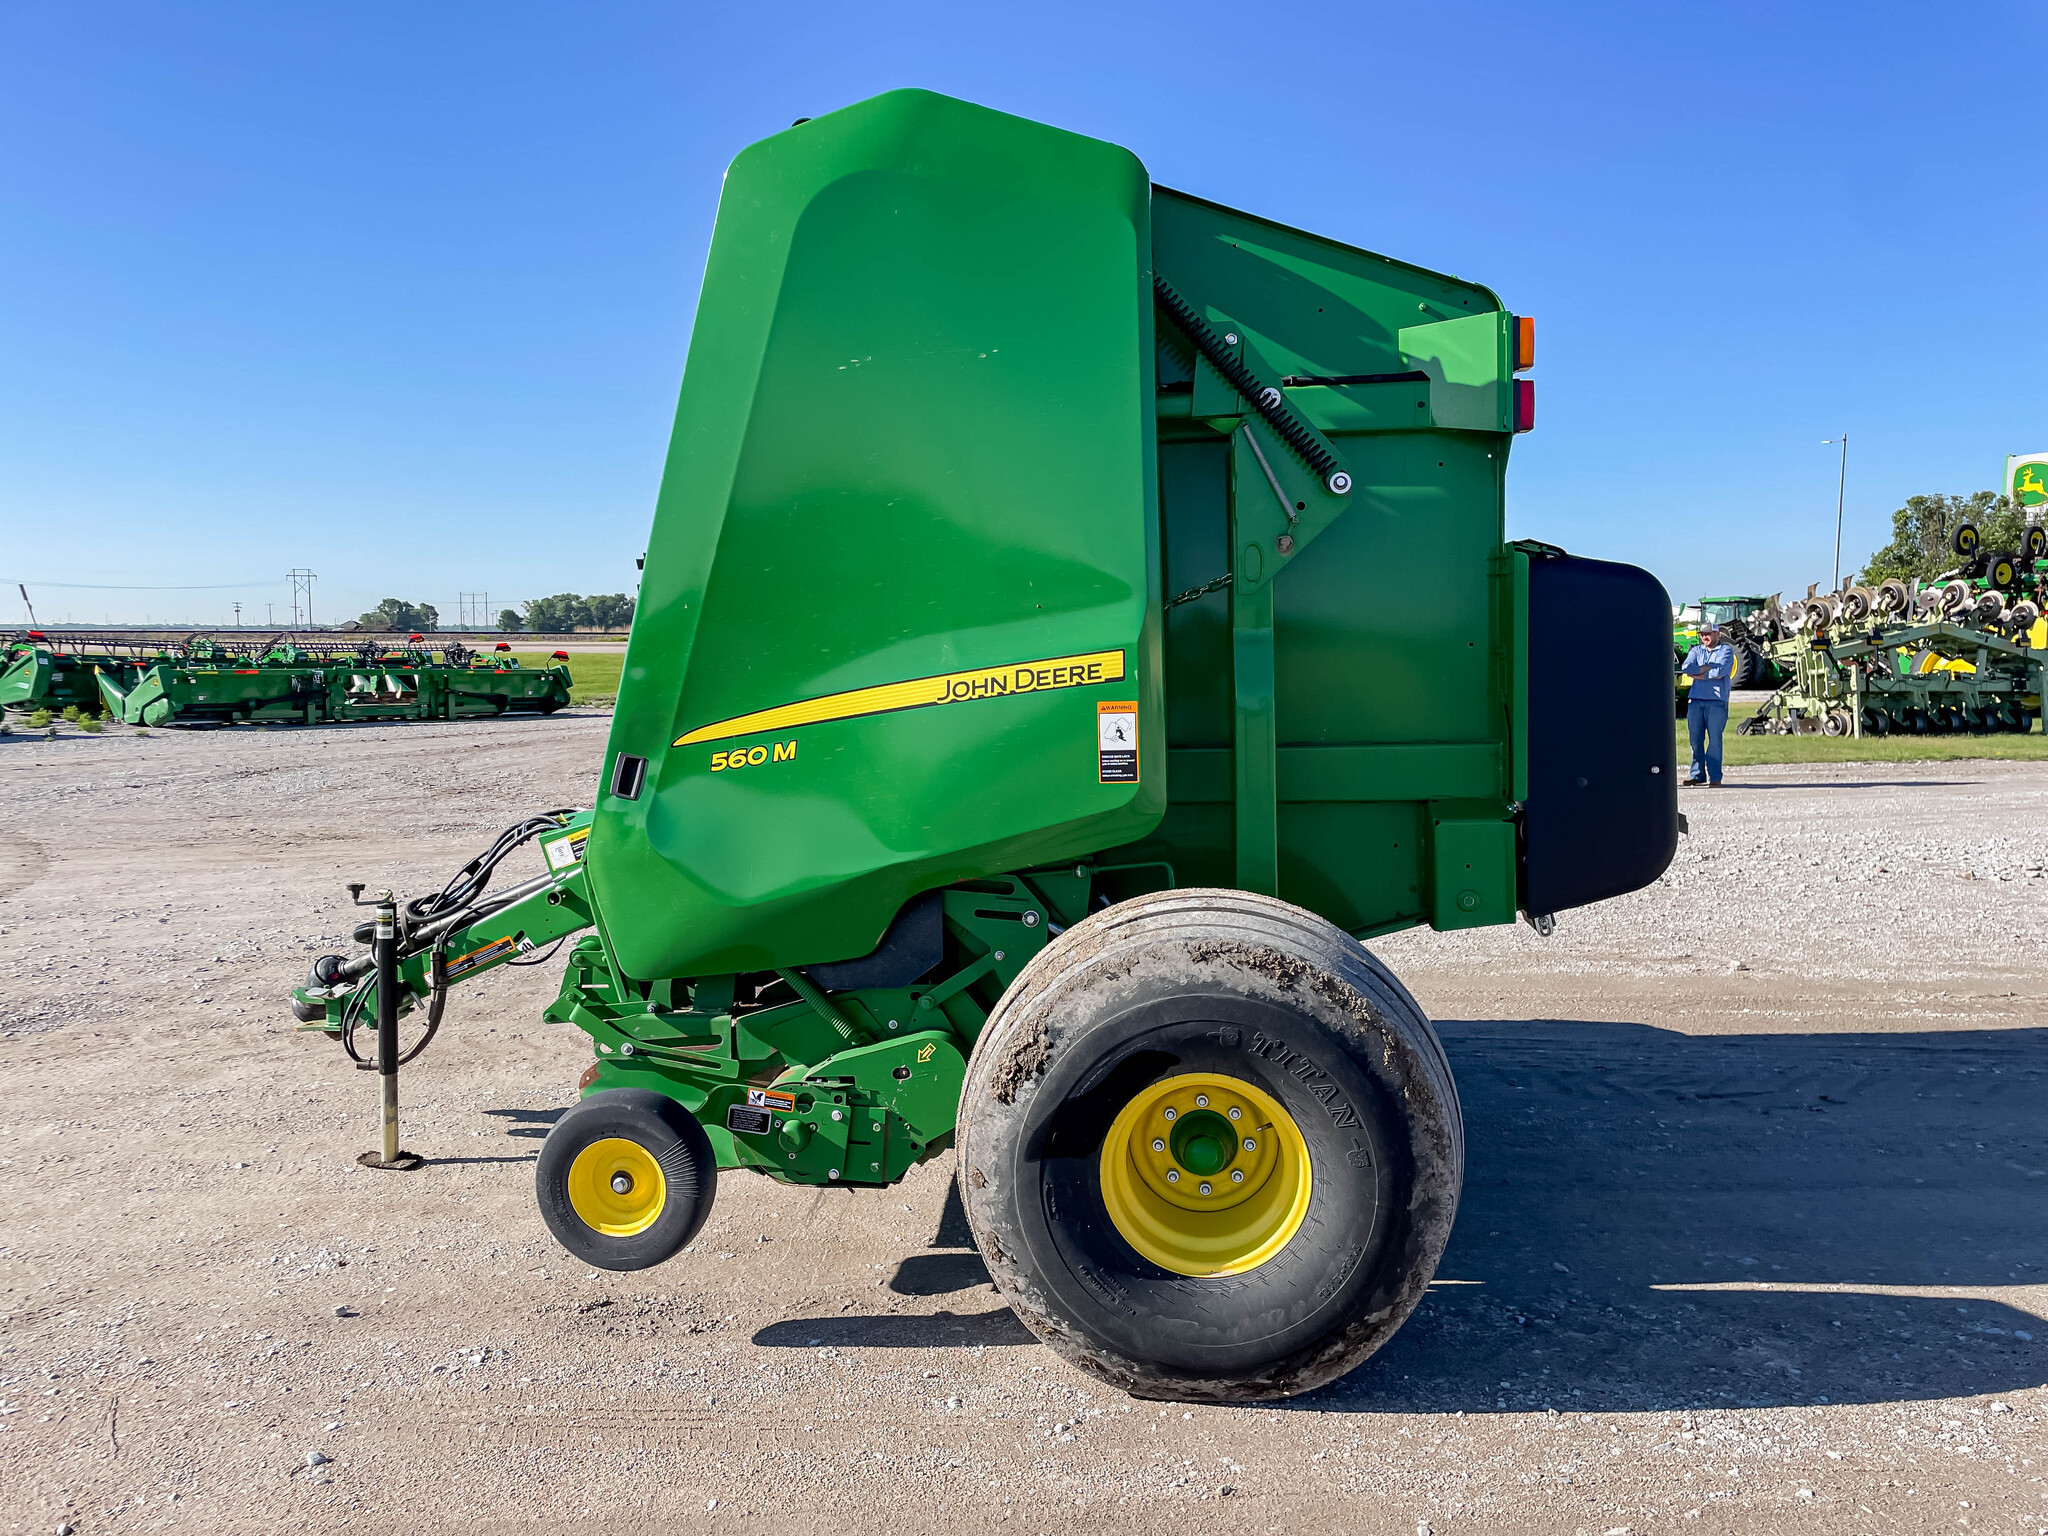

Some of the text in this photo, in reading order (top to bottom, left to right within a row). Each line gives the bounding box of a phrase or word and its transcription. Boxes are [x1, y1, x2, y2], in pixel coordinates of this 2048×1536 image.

[937, 663, 1103, 701] JOHN DEERE
[710, 739, 798, 773] 560 M
[1248, 1031, 1364, 1130] TITAN
